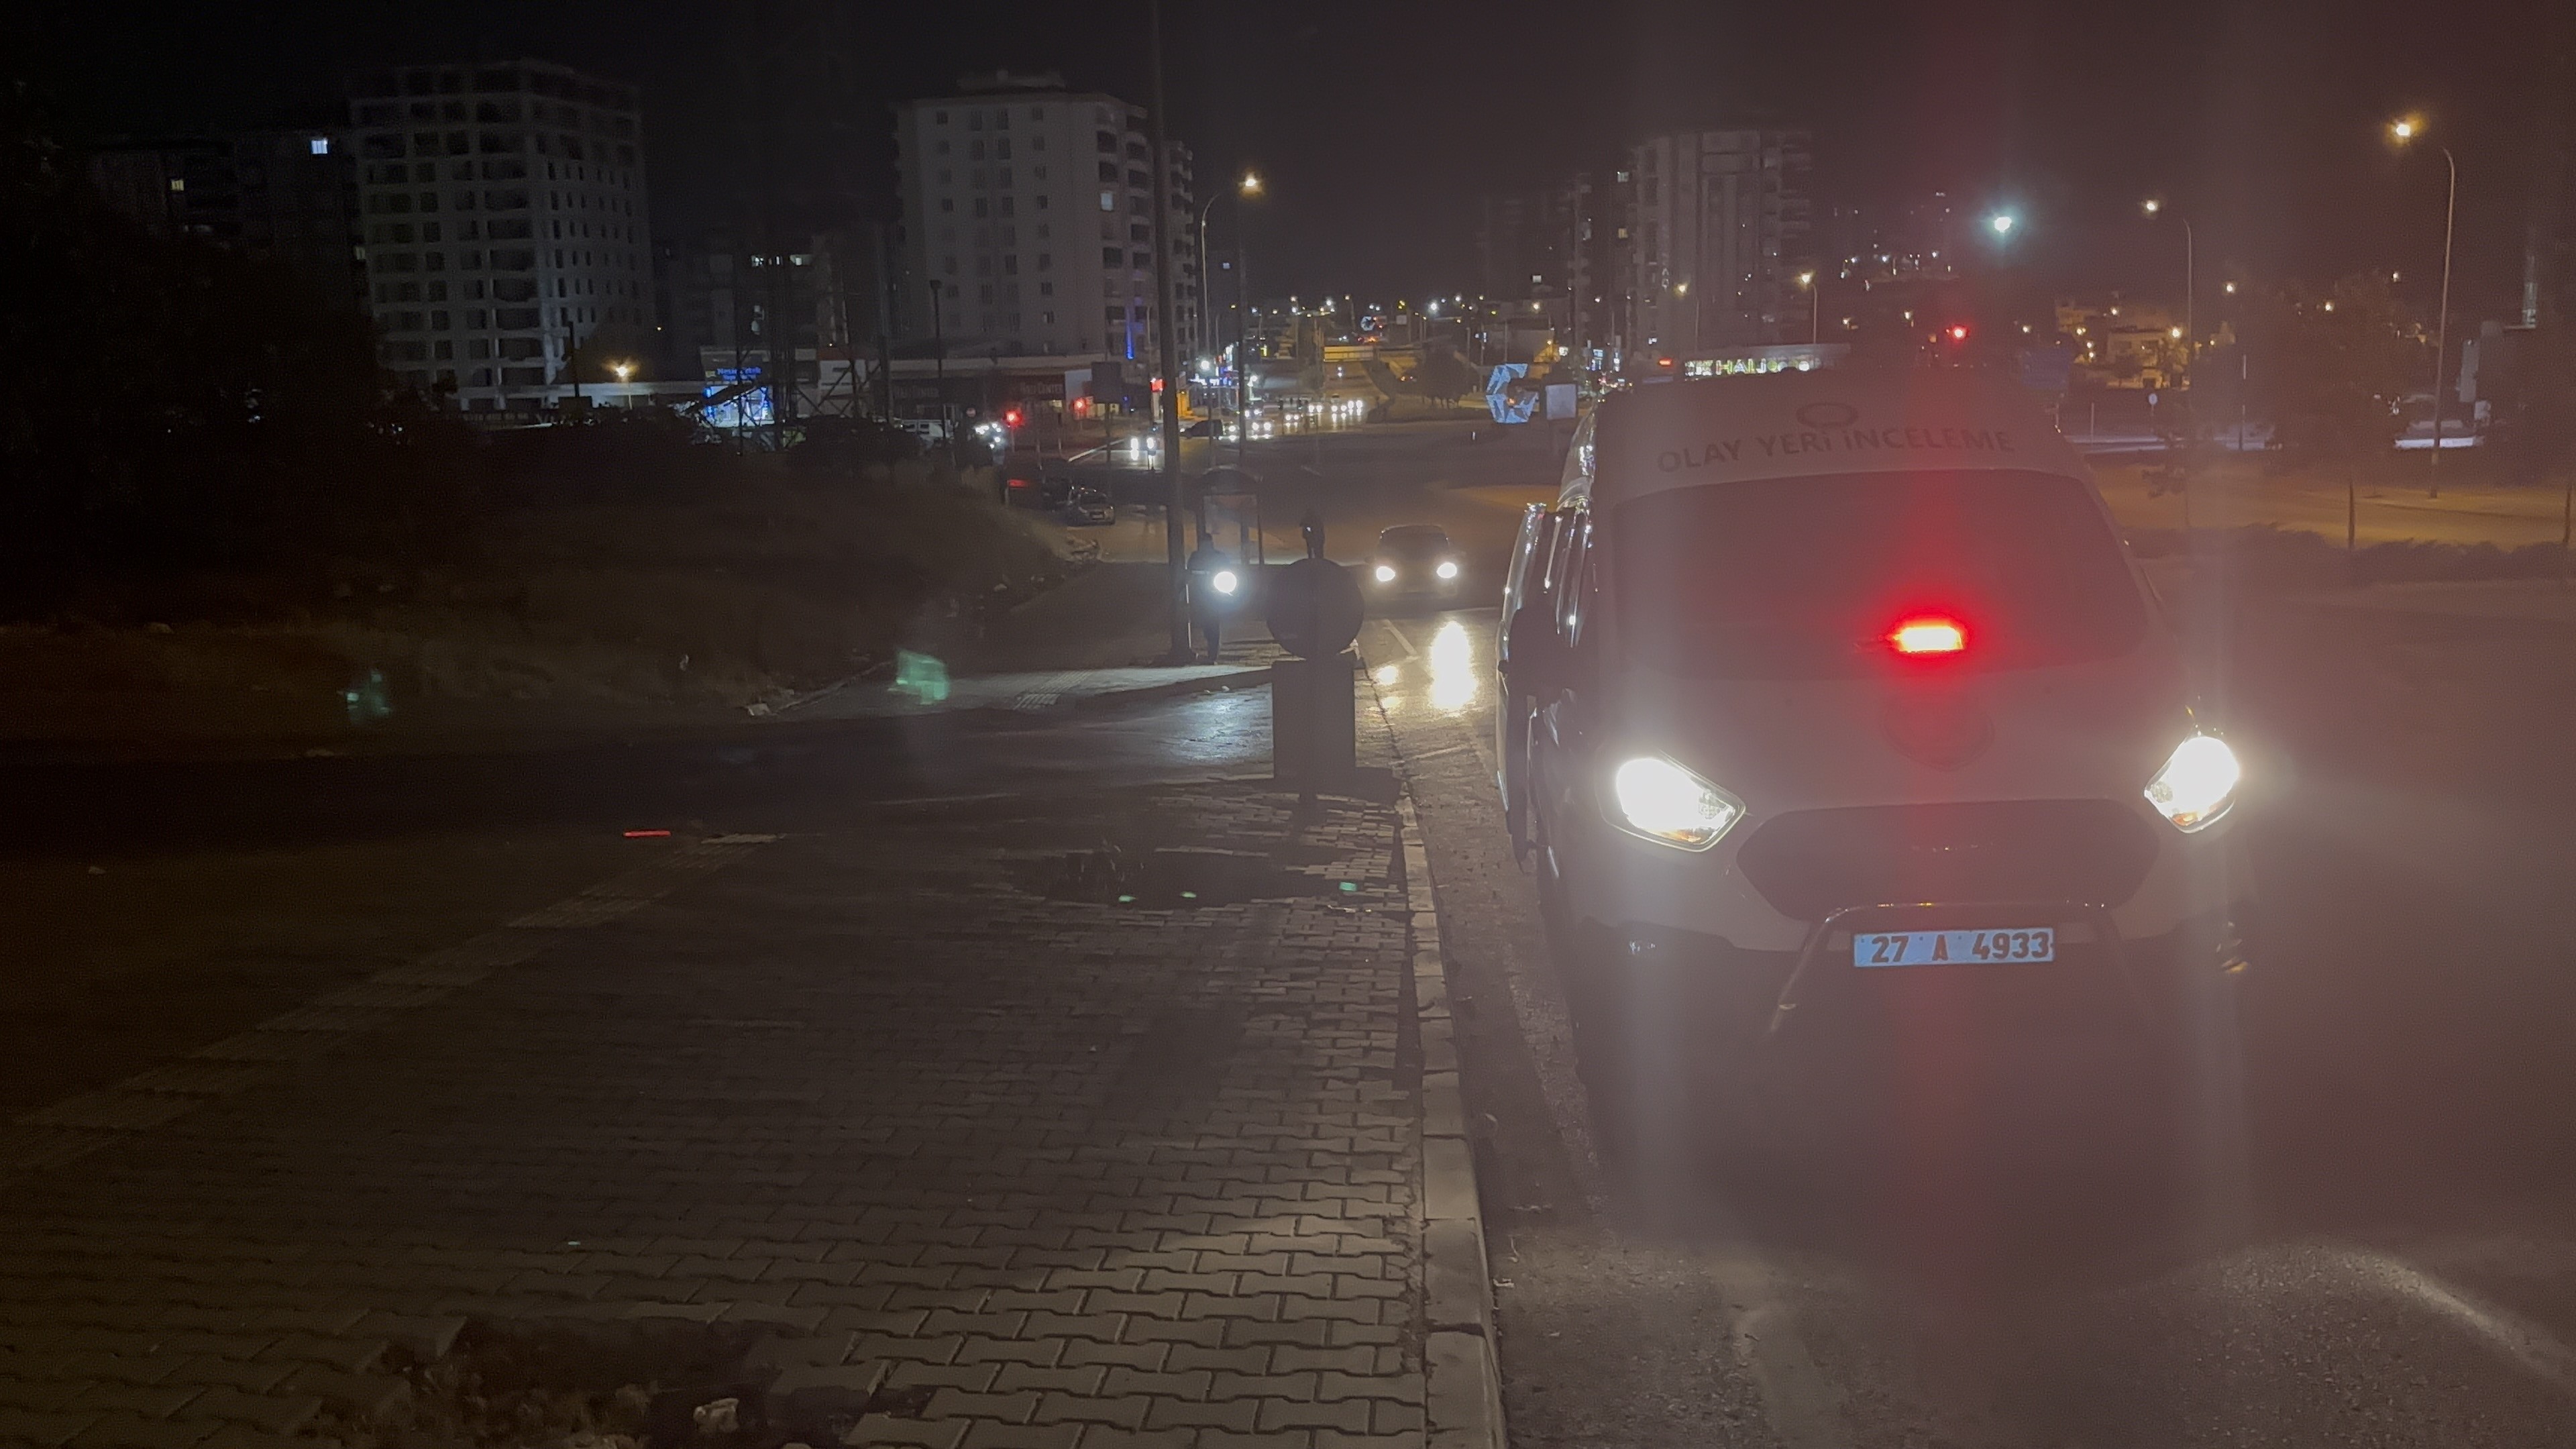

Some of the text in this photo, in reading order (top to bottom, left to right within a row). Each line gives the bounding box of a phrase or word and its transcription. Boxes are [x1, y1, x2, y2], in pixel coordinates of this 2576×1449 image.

[1657, 439, 1741, 472] OLAY
[1872, 931, 2049, 963] 27 A 4933
